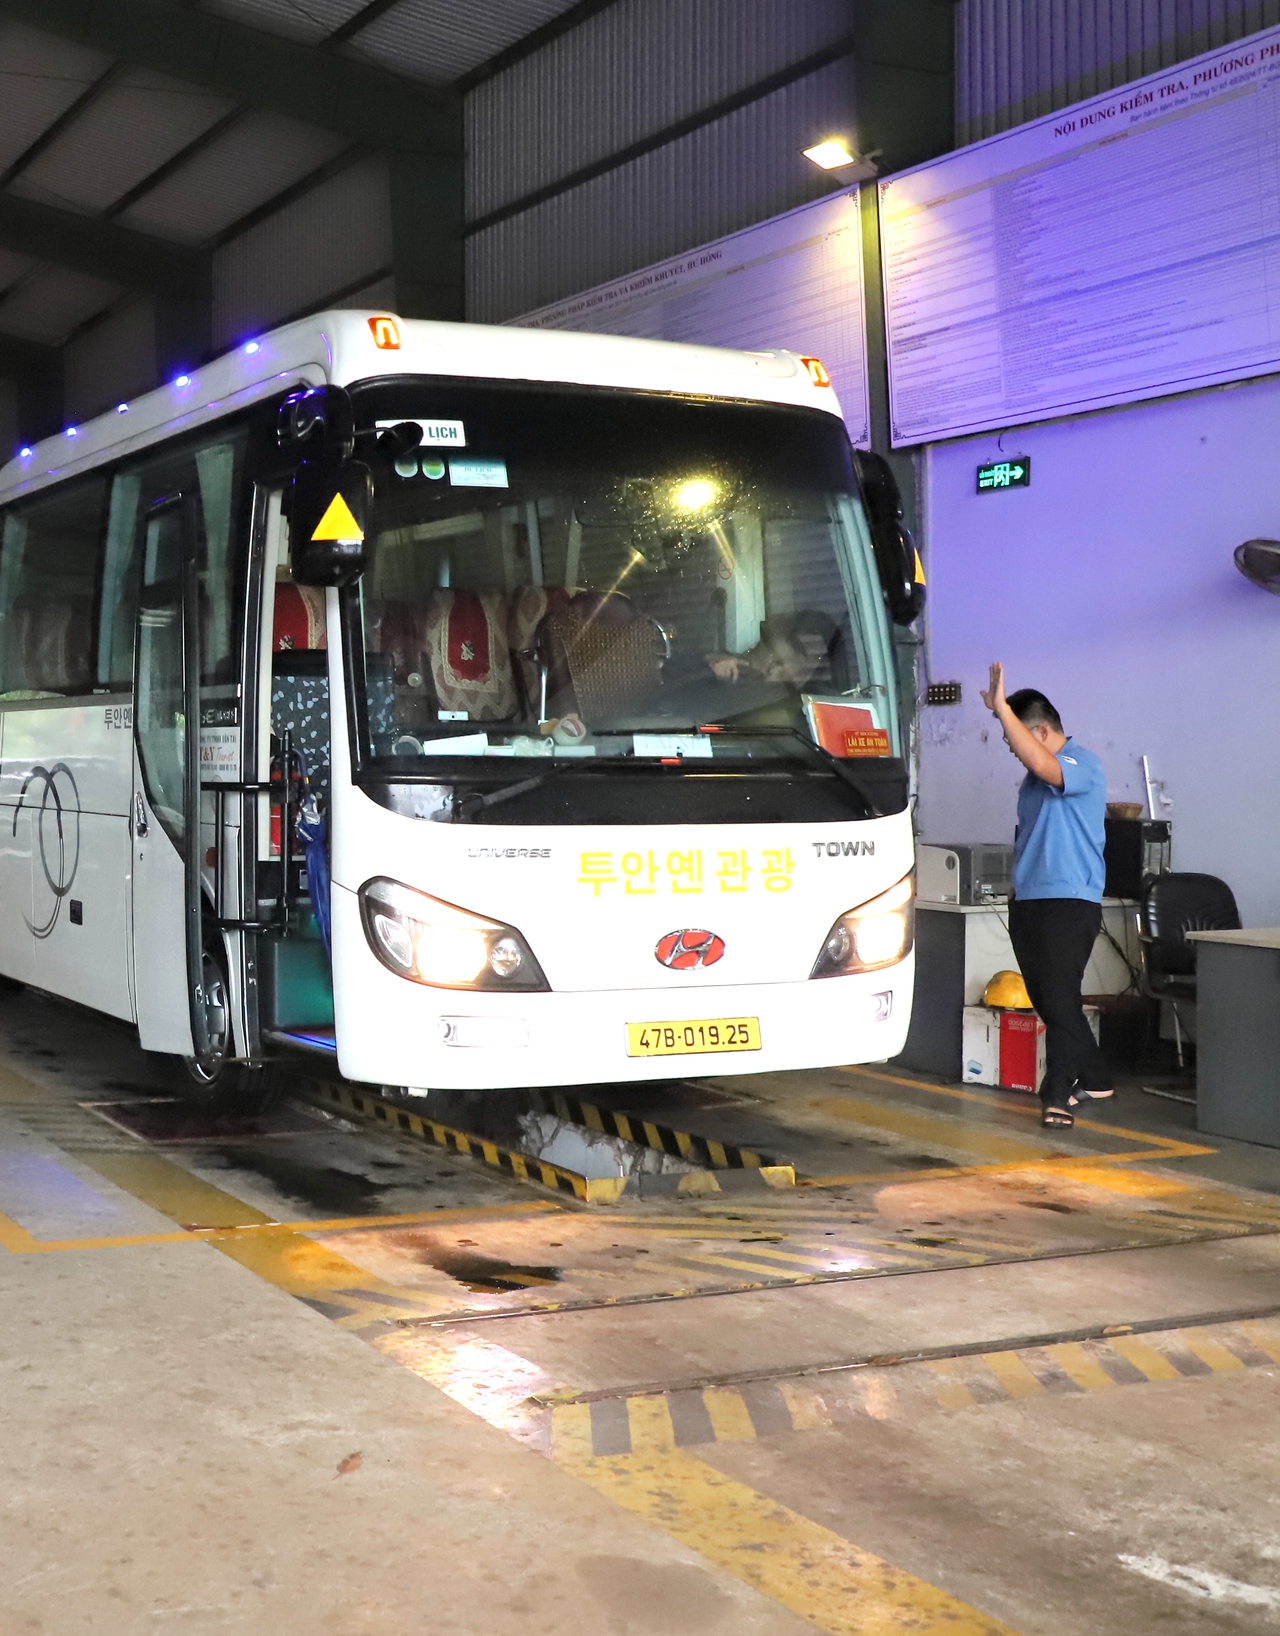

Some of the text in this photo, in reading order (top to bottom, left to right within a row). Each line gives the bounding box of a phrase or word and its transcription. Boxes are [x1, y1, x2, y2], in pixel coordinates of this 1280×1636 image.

[1054, 120, 1076, 138] NỘI
[1079, 107, 1116, 129] DUNG
[1157, 79, 1189, 99] TRA,
[1193, 53, 1255, 86] PHƯƠNG
[429, 426, 458, 441] LỊCH
[467, 848, 552, 859] UNIVERSE
[811, 841, 875, 858] TOWN
[639, 1023, 750, 1049] 47B-019.25
